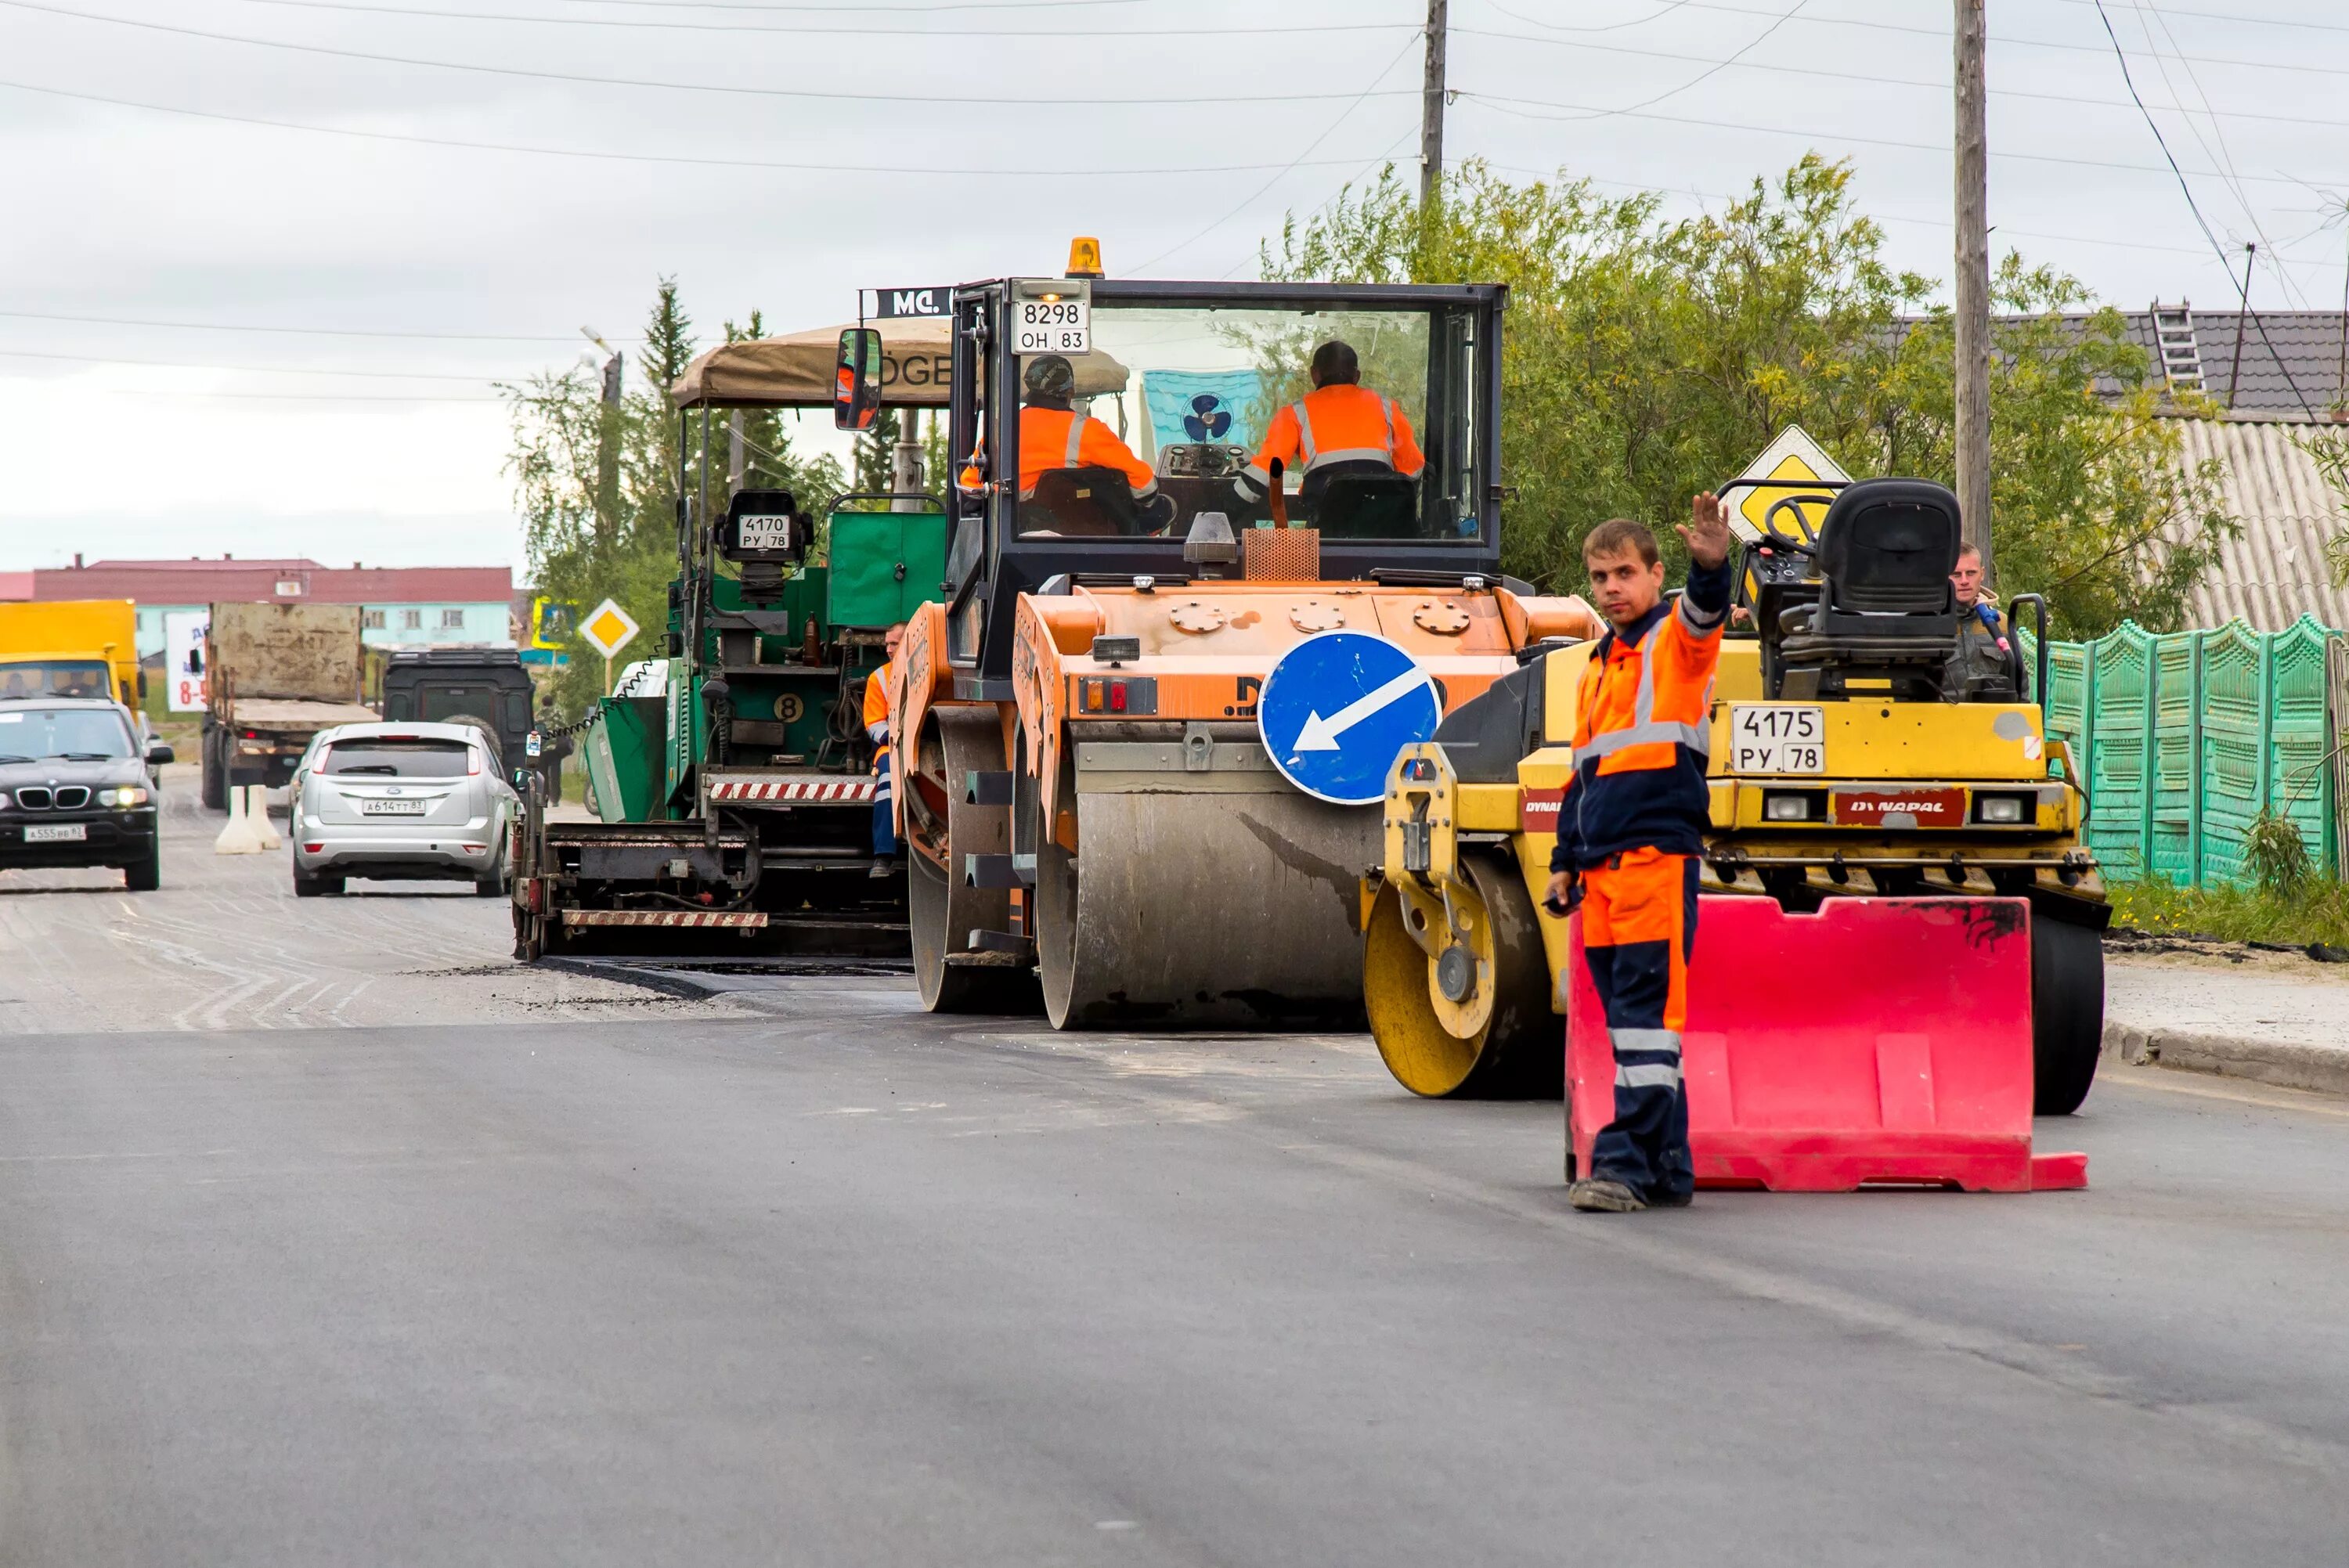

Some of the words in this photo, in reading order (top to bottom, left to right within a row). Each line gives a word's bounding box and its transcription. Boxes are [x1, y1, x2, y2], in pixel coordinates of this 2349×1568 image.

[1025, 305, 1078, 324] 8298
[1062, 333, 1082, 348] 83
[745, 518, 783, 531] 4170
[770, 535, 785, 546] 78
[781, 697, 796, 718] 8
[1744, 711, 1813, 737] 4175
[1791, 748, 1817, 767] 78
[1525, 802, 1562, 812] DYNA
